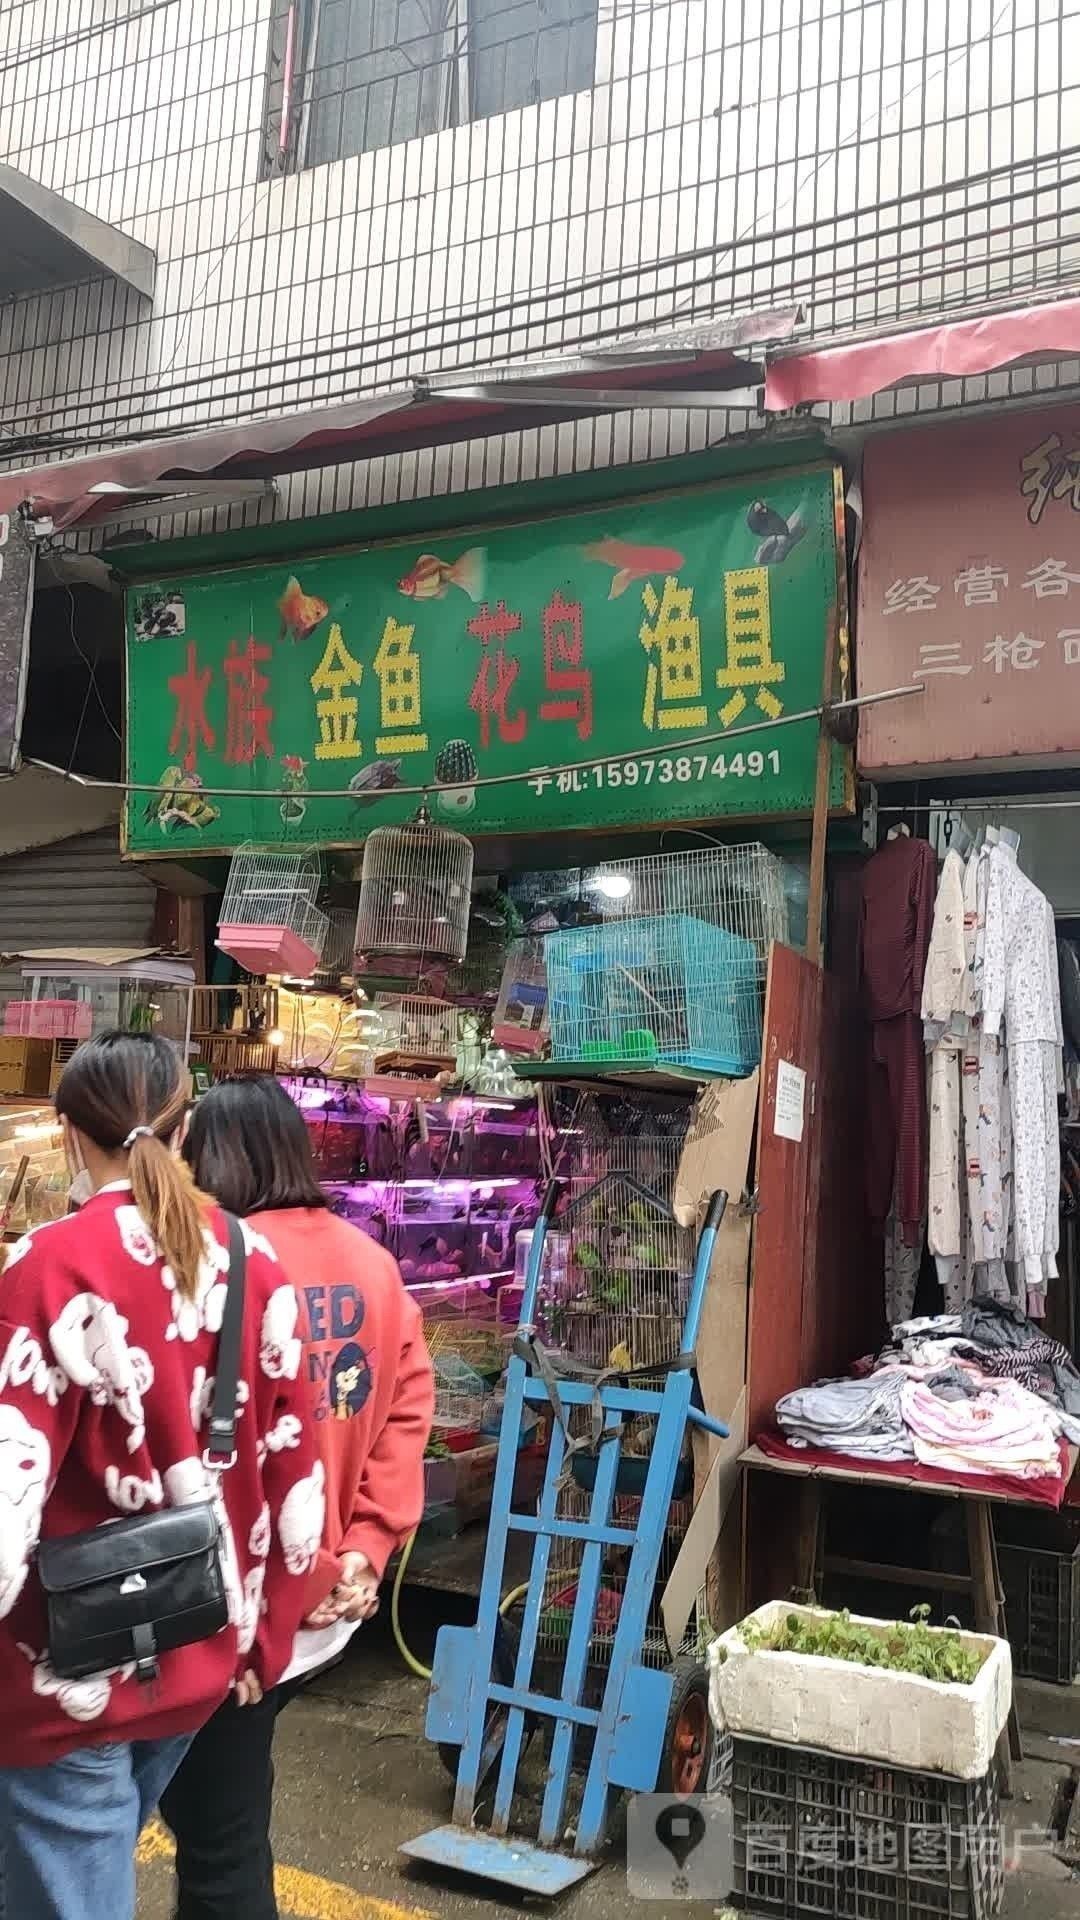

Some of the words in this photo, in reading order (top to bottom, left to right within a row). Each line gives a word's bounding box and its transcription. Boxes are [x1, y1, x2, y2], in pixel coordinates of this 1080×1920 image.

[881, 557, 1080, 615] 经营各
[168, 638, 275, 772] 水族
[310, 617, 429, 760] 金鱼
[466, 591, 593, 750] 花鸟
[638, 566, 786, 731] 渔具
[298, 1284, 366, 1343] ED
